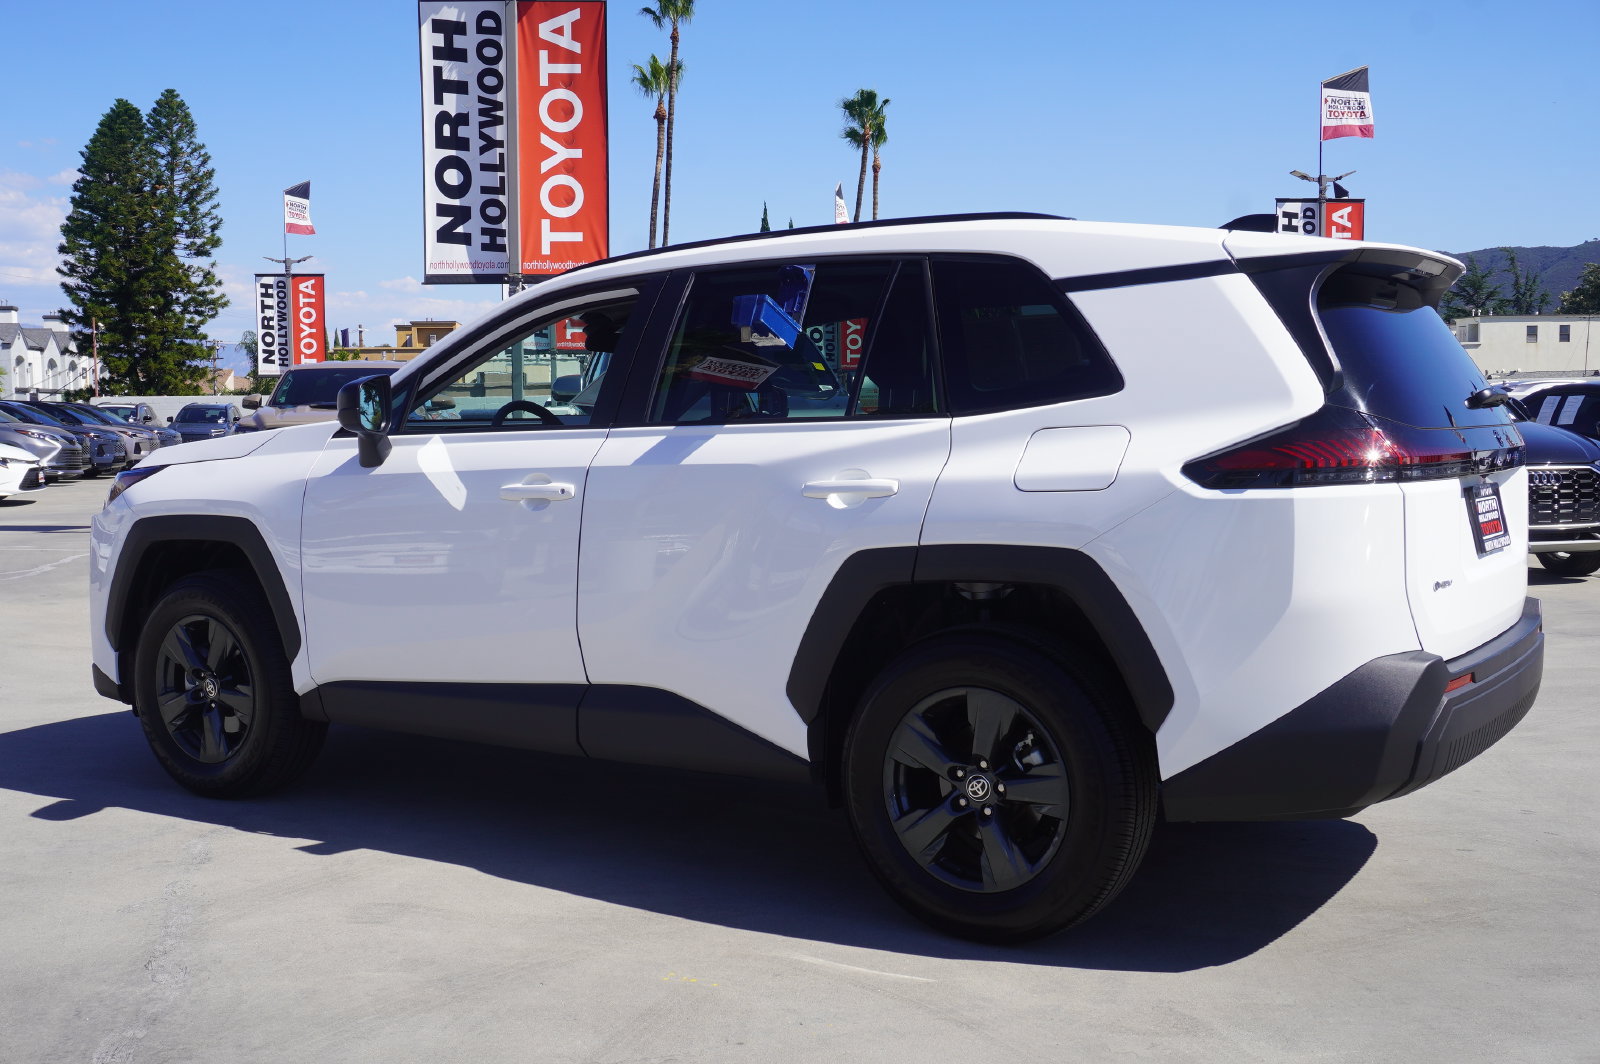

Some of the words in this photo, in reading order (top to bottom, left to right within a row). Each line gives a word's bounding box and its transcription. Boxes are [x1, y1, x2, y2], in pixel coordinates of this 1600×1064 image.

[430, 18, 473, 247] NORTH
[475, 9, 507, 253] HOLLYWOOD
[538, 7, 585, 255] TOYOTA
[1327, 110, 1367, 118] TOYOTA
[429, 259, 510, 272] northhollywoodtoyota.com
[259, 282, 276, 365] NORTH
[276, 279, 289, 367] HOLLYWOOD
[298, 279, 318, 365] TOYOTA
[1477, 499, 1498, 514] NORTH
